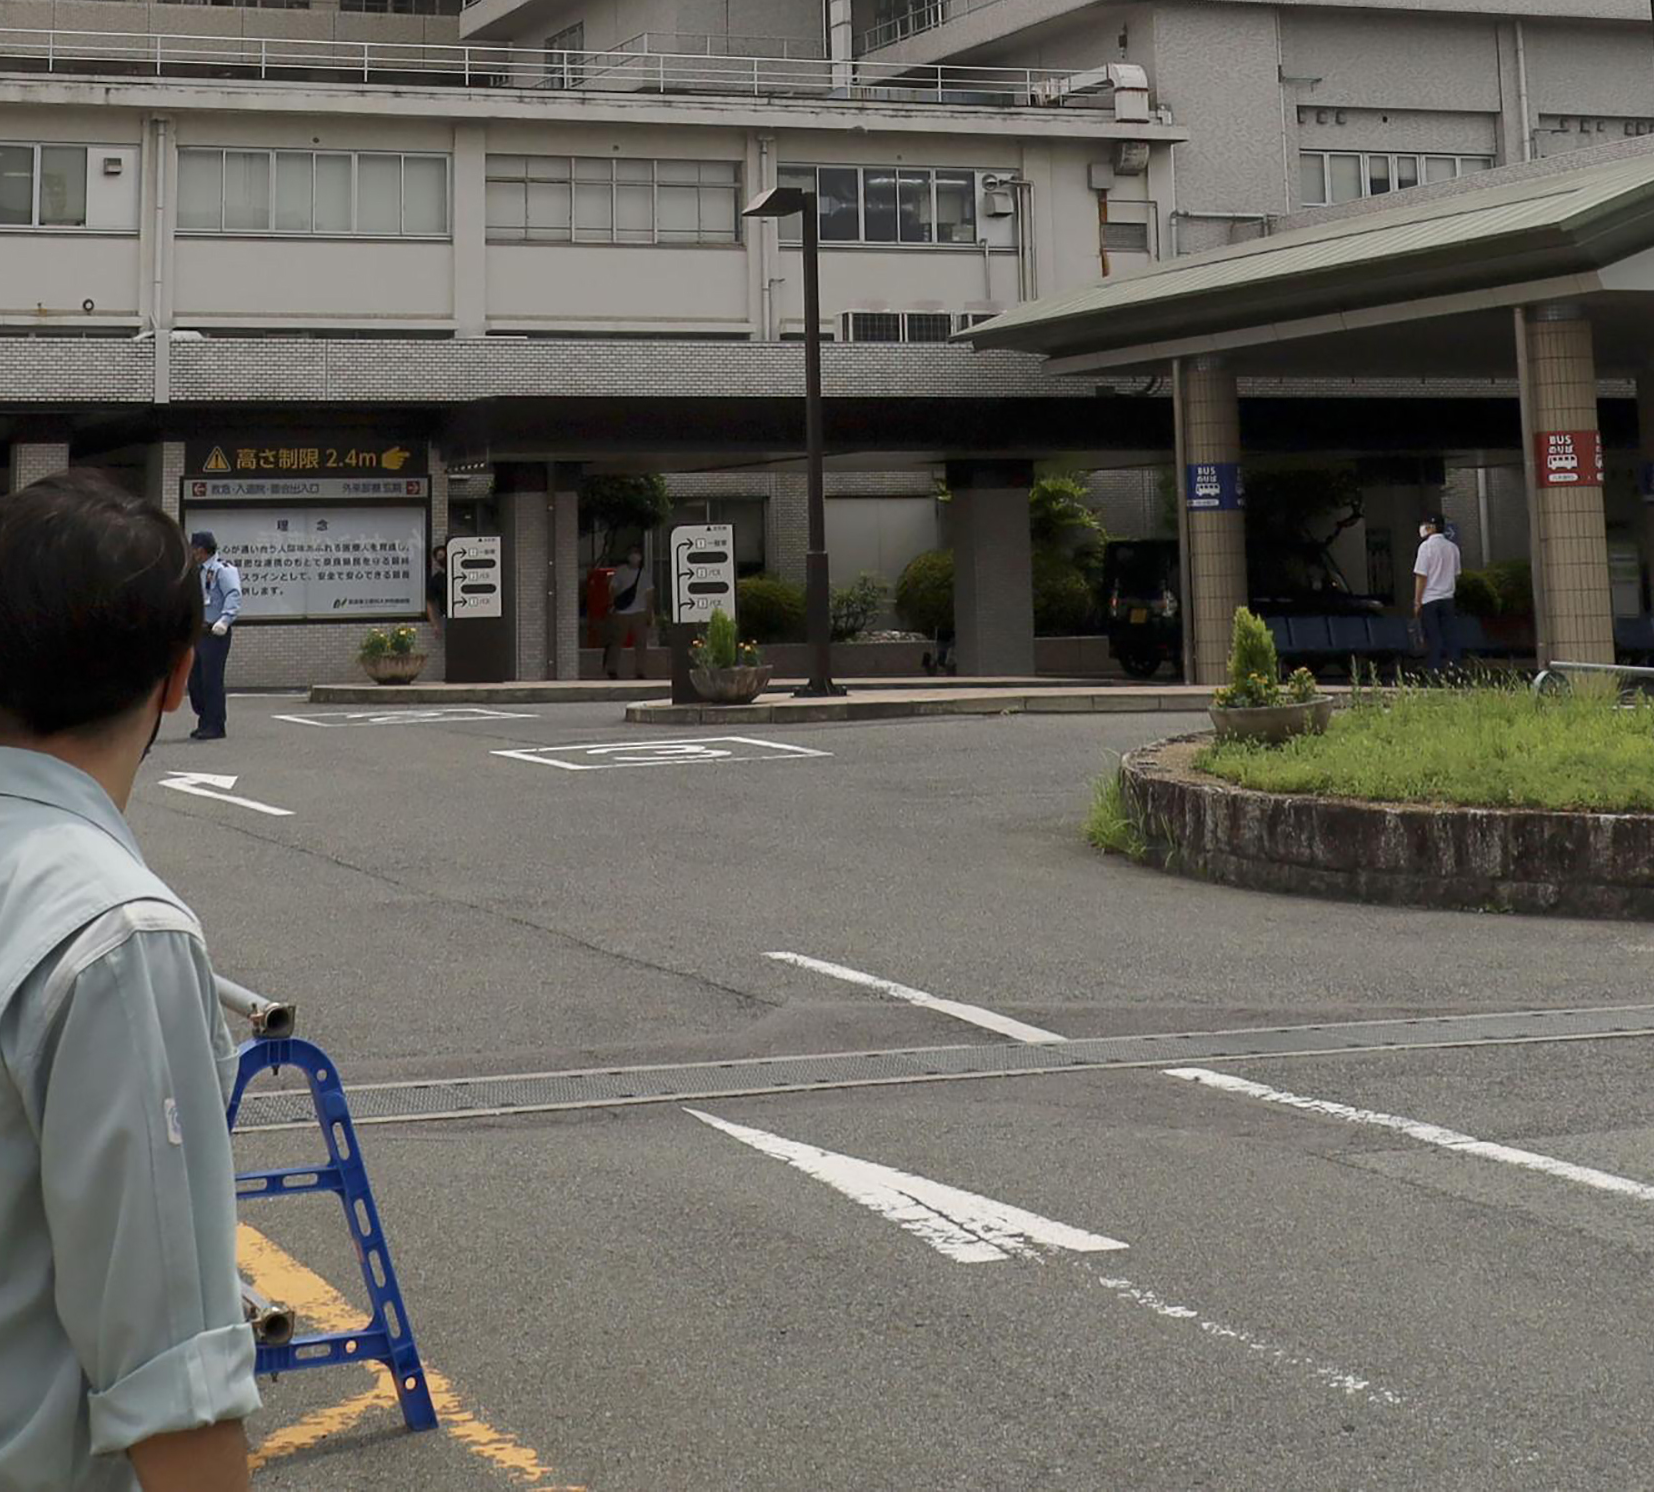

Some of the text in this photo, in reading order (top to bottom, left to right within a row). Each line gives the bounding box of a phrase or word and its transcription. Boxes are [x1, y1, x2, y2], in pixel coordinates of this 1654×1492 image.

[1549, 435, 1572, 445] BUS
[236, 448, 377, 469] 高さ制限 2.4m
[1197, 466, 1216, 475] BUS
